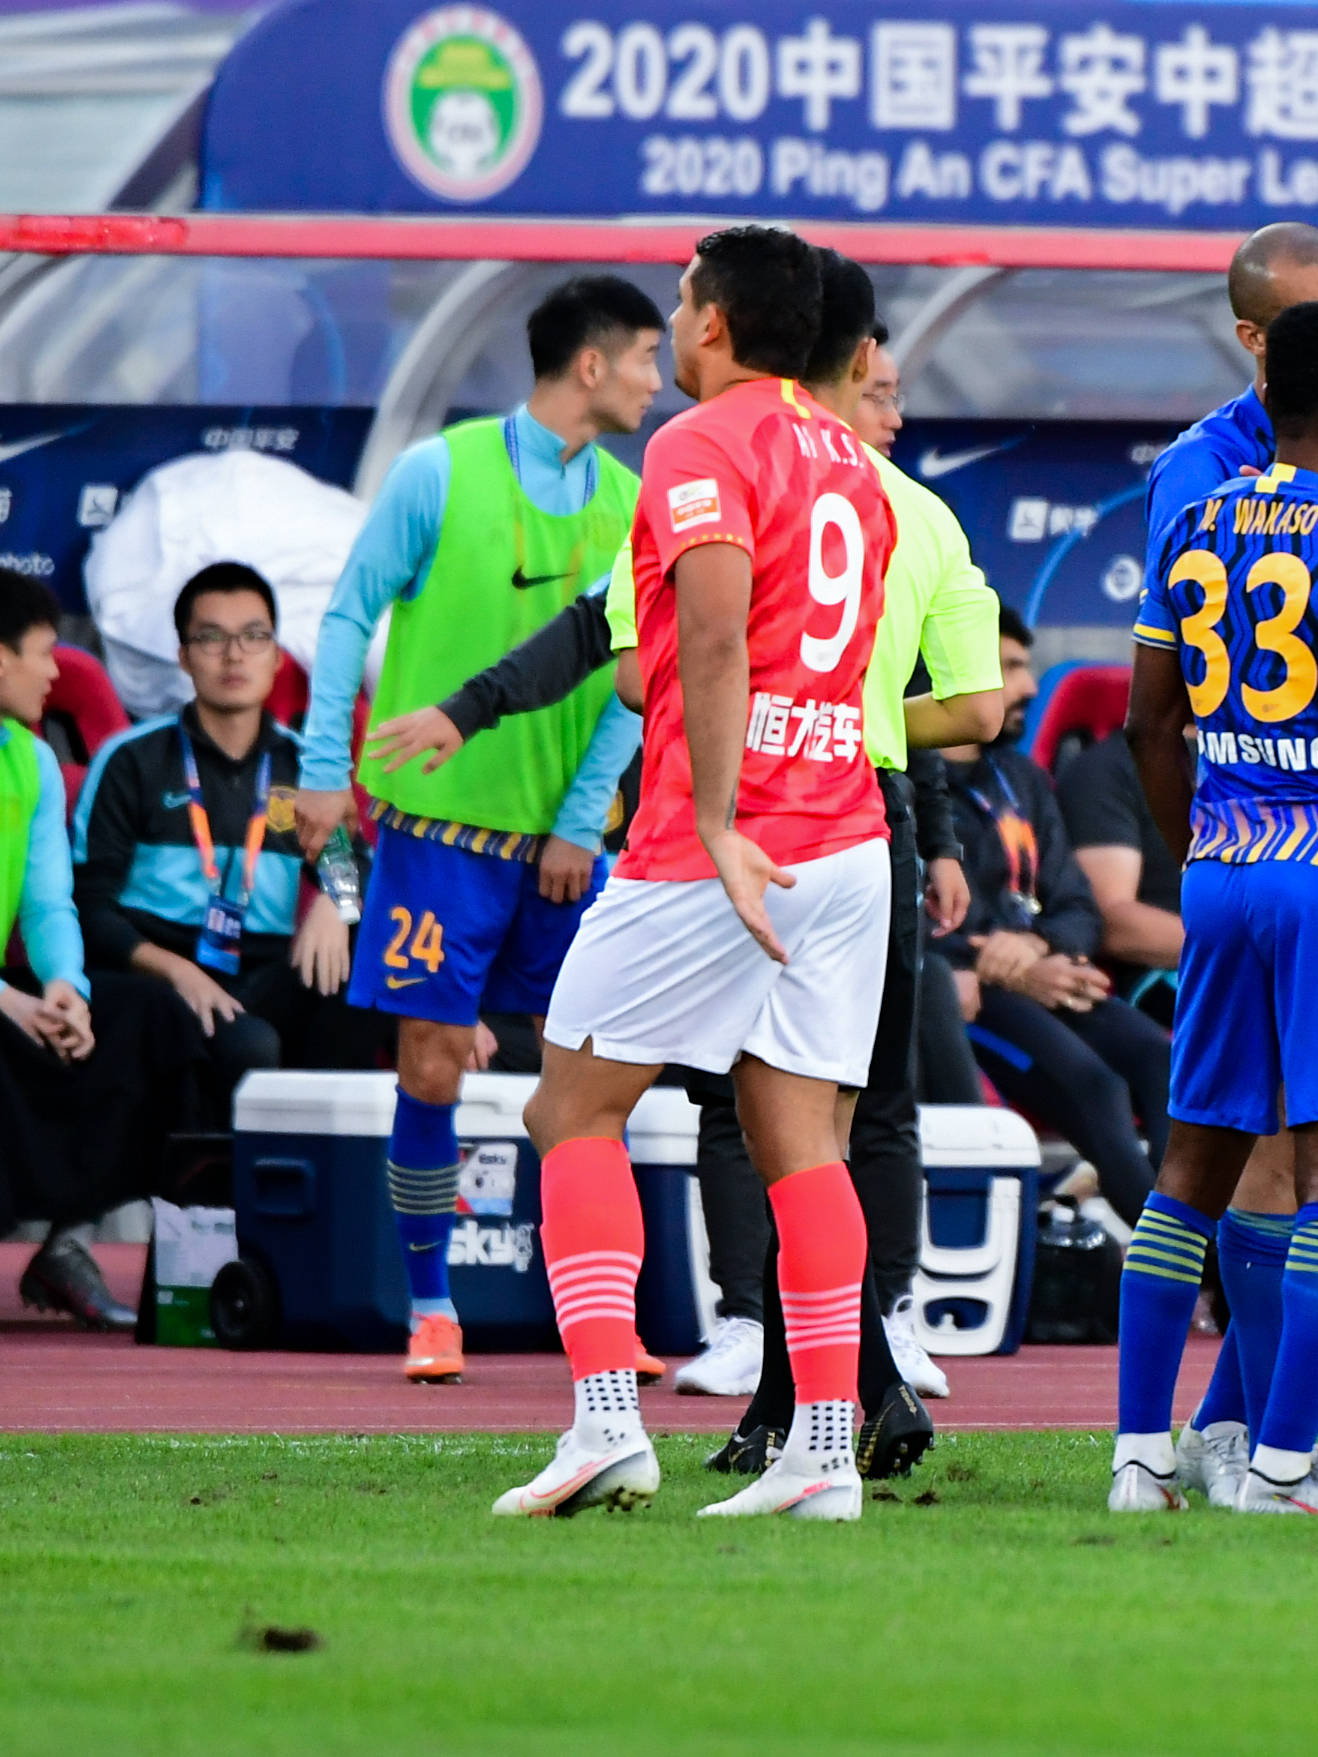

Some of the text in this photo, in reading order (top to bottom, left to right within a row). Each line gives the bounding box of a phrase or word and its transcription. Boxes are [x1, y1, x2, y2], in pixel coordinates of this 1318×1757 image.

[642, 137, 763, 195] 2020
[772, 137, 888, 212] Ping
[899, 142, 971, 200] An
[981, 142, 1092, 202] CFA
[1100, 144, 1250, 213] Super
[800, 492, 865, 673] 9
[1168, 549, 1318, 723] 33
[384, 905, 445, 973] 24
